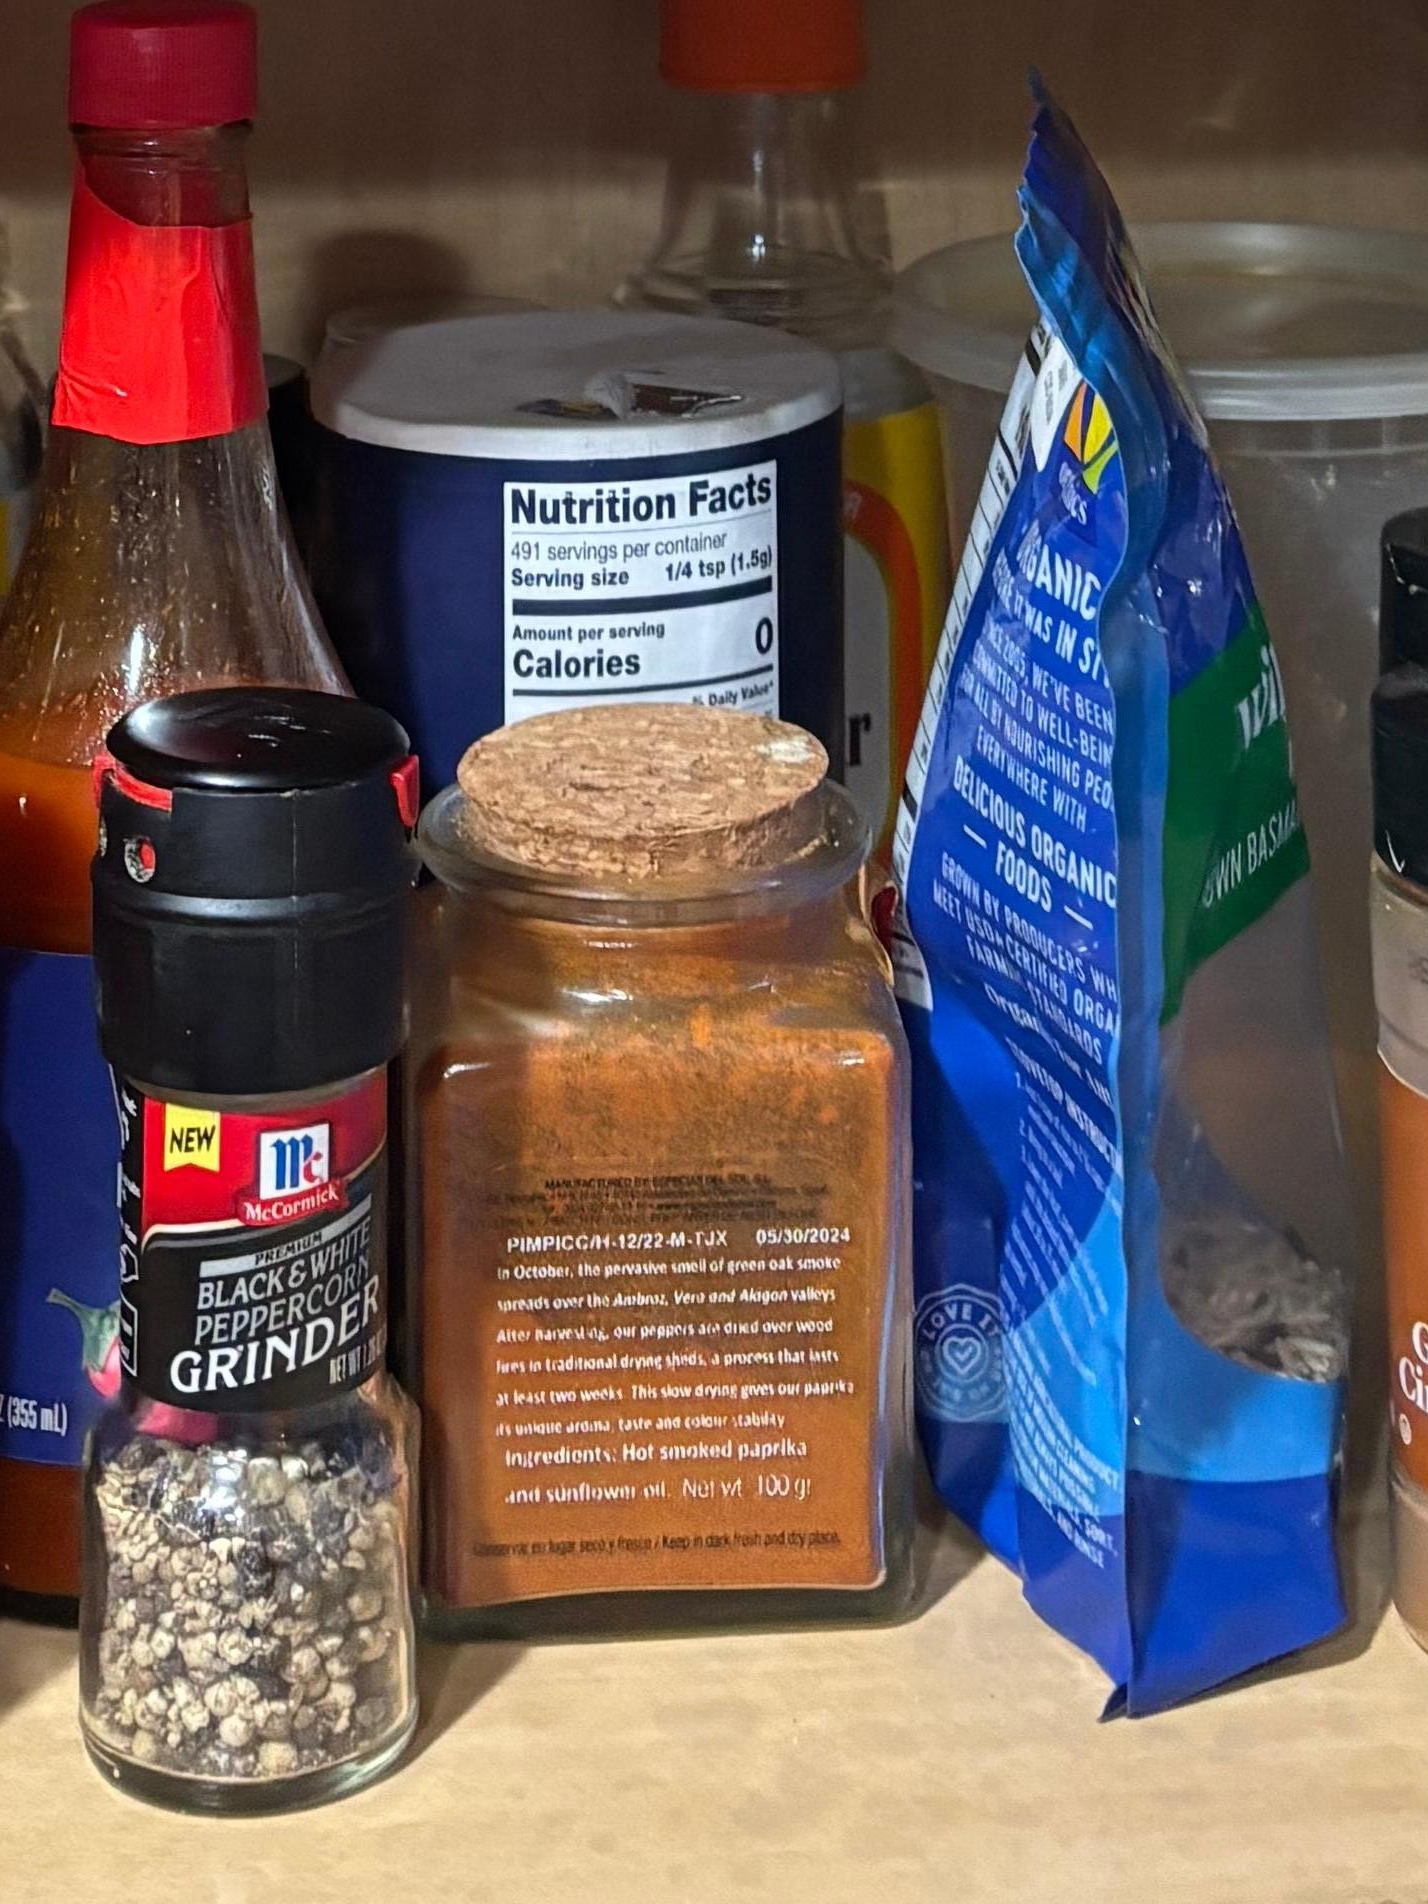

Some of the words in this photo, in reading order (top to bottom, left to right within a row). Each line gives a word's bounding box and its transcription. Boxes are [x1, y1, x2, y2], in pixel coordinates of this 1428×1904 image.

[511, 487, 675, 525] Nutrition
[689, 473, 771, 516] Facts
[512, 541, 540, 560] 491
[548, 541, 617, 563] servings
[623, 542, 649, 562] per
[655, 532, 727, 556] container
[511, 568, 584, 590] Serving
[592, 568, 629, 585] size
[666, 562, 692, 581] 1/4
[699, 559, 725, 578] tsp
[513, 624, 572, 641] Amount
[578, 625, 603, 643] per
[609, 622, 665, 639] serving
[755, 617, 772, 655] 0
[513, 648, 640, 678] Calories
[708, 690, 738, 706] Daily
[1075, 693, 1114, 735] BEEN
[1053, 786, 1087, 833] WITH
[953, 755, 1025, 848] DELICIOUS
[1031, 824, 1117, 908] ORGANIC
[942, 852, 979, 908] GROWN
[995, 840, 1052, 913] FOODS
[933, 879, 962, 923] MEET
[170, 1124, 216, 1154] NEW
[243, 1185, 339, 1223] McCormick
[254, 1233, 323, 1267] PREMIUM
[756, 1228, 851, 1246] 05/30/2024
[197, 1265, 284, 1311] BLACK
[288, 1260, 307, 1288] &
[310, 1216, 371, 1278] WHITE
[194, 1255, 370, 1346] PEPPERCORN
[170, 1274, 379, 1393] GRINDER
[7, 1396, 37, 1428] (355
[505, 1445, 617, 1469] Ingredients:
[622, 1442, 654, 1463] Hot
[660, 1439, 733, 1461] smoked
[738, 1437, 808, 1463] paprika
[546, 1481, 637, 1504] sunflower
